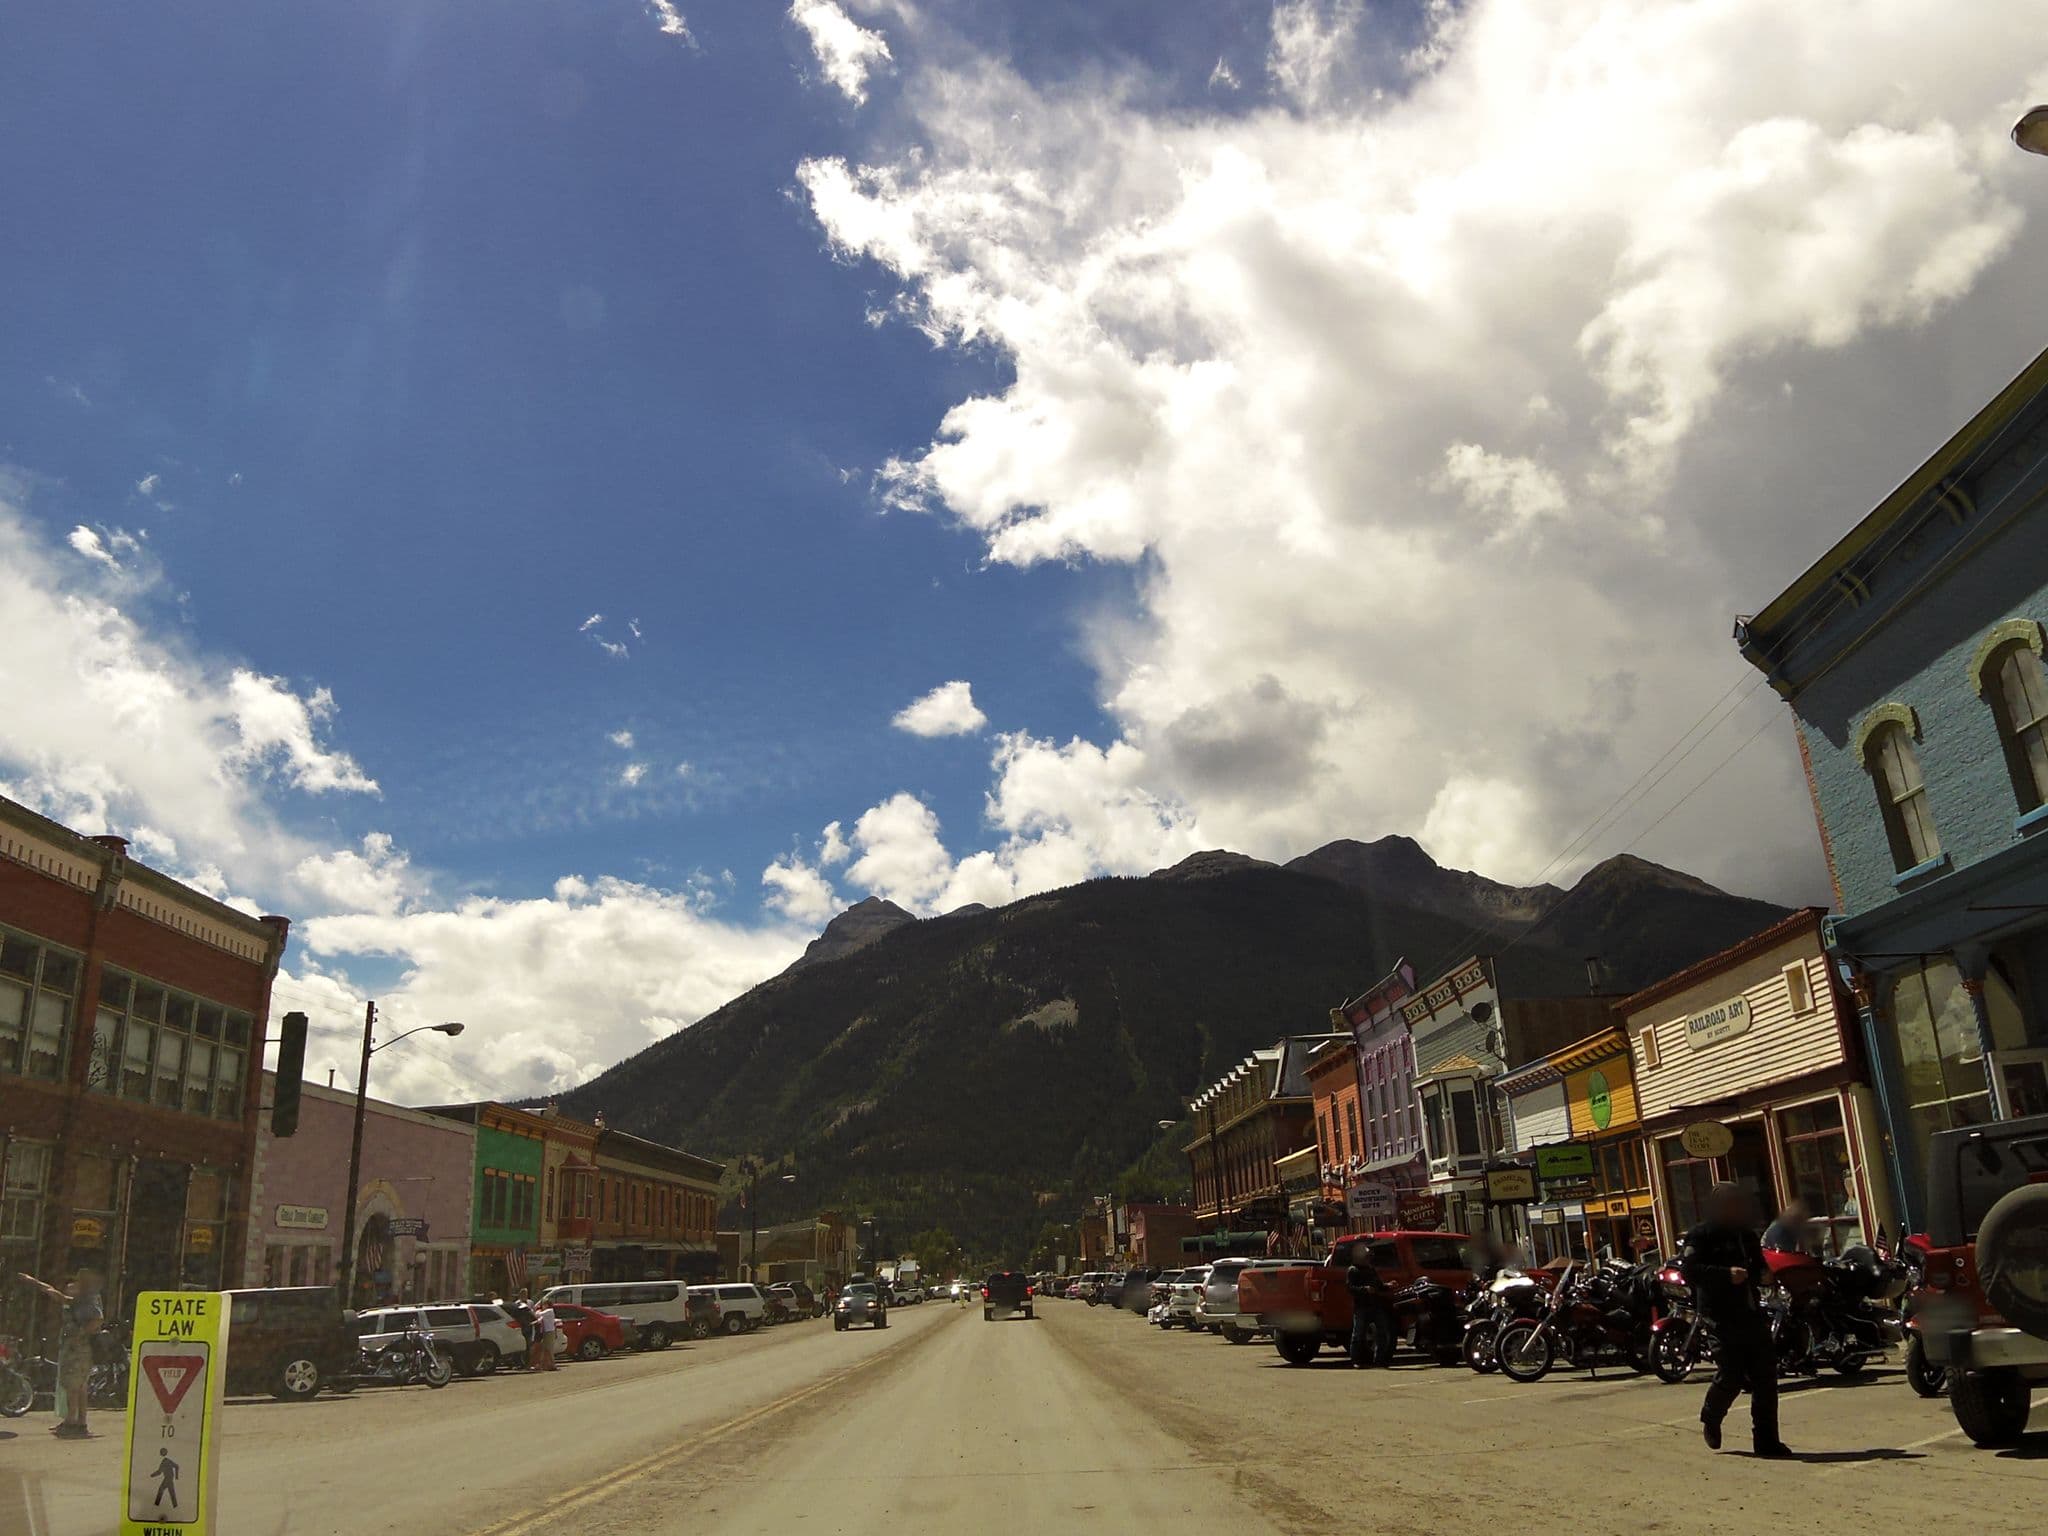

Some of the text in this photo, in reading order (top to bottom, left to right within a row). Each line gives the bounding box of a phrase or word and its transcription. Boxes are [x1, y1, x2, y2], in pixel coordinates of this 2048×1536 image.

[1688, 1001, 1744, 1035] RAILROAD ART
[1354, 1195, 1388, 1204] MOUNTAIN
[1413, 1208, 1435, 1221] GIFTS
[151, 1299, 206, 1315] STATE
[158, 1320, 194, 1335] LAW
[161, 1425, 175, 1438] TO
[143, 1527, 183, 1536] WITHIN
